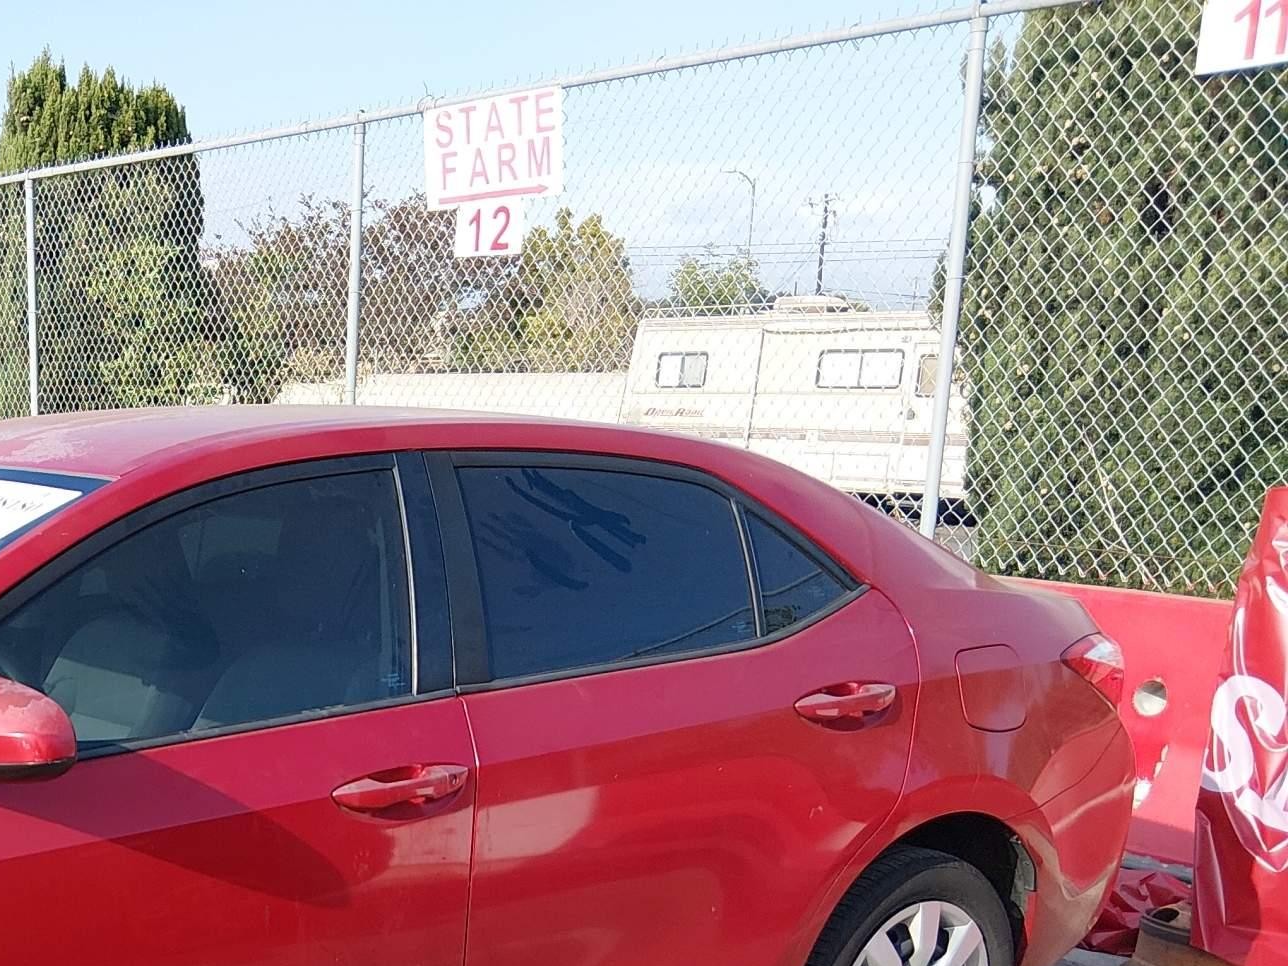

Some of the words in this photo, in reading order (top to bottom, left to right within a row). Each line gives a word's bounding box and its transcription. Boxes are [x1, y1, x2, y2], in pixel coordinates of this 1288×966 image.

[435, 91, 556, 148] STATE
[441, 136, 551, 190] FARM
[469, 205, 510, 252] 12
